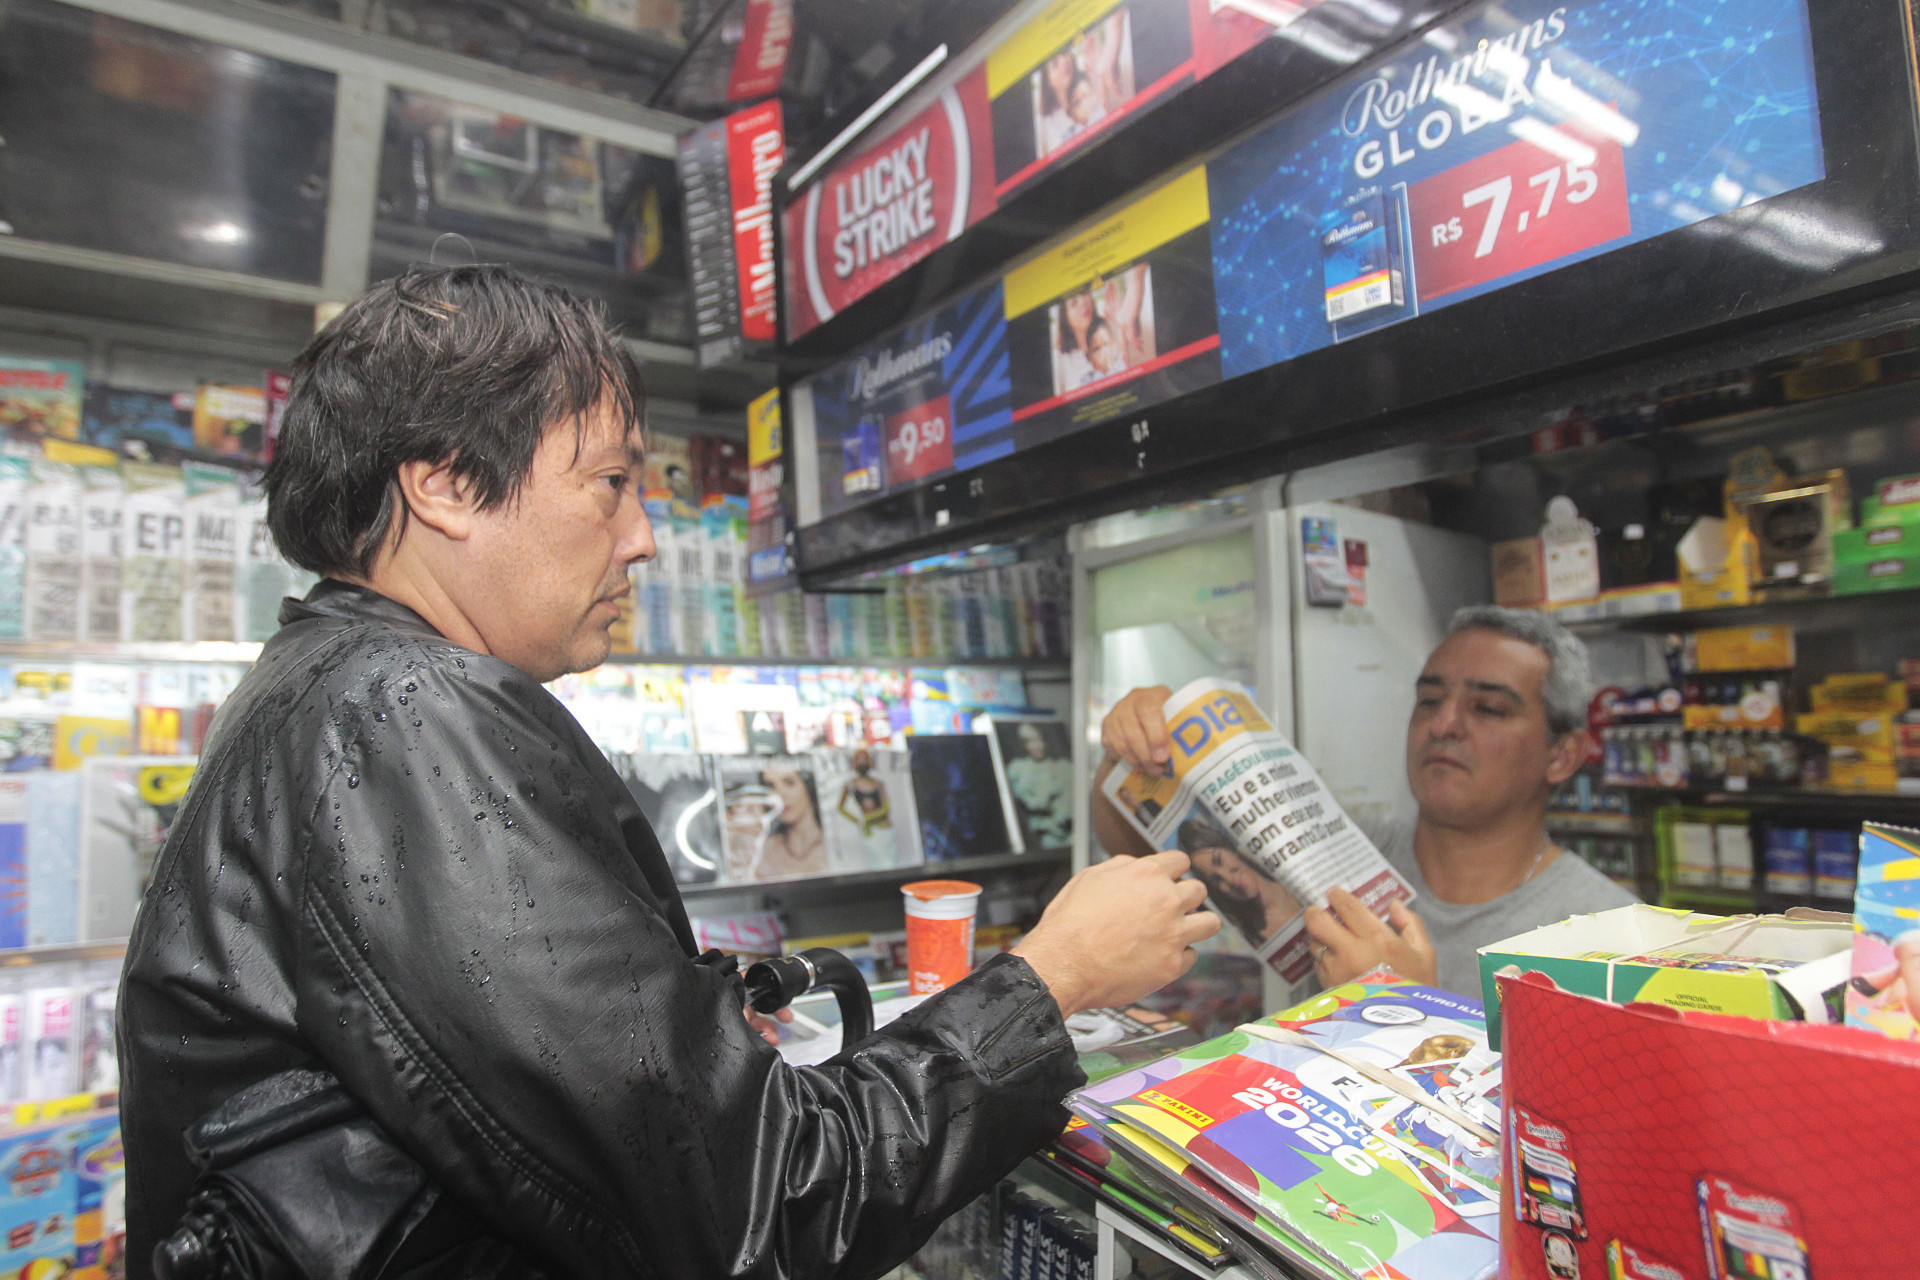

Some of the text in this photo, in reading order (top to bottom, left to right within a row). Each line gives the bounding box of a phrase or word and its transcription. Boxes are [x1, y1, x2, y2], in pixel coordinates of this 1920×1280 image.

[836, 127, 930, 228] LUCKY
[1431, 160, 1599, 259] R$ 7,75
[834, 178, 937, 278] STRIKE
[851, 331, 952, 400] Rothmans
[900, 416, 946, 465] 9,50
[1243, 780, 1258, 795] e
[1257, 771, 1271, 786] a
[1412, 992, 1458, 1008] LIVRO
[1162, 1098, 1209, 1123] PANINI
[1231, 1087, 1380, 1177] 2026
[1263, 1077, 1347, 1131] WORLD
[1345, 1125, 1400, 1161] CUP
